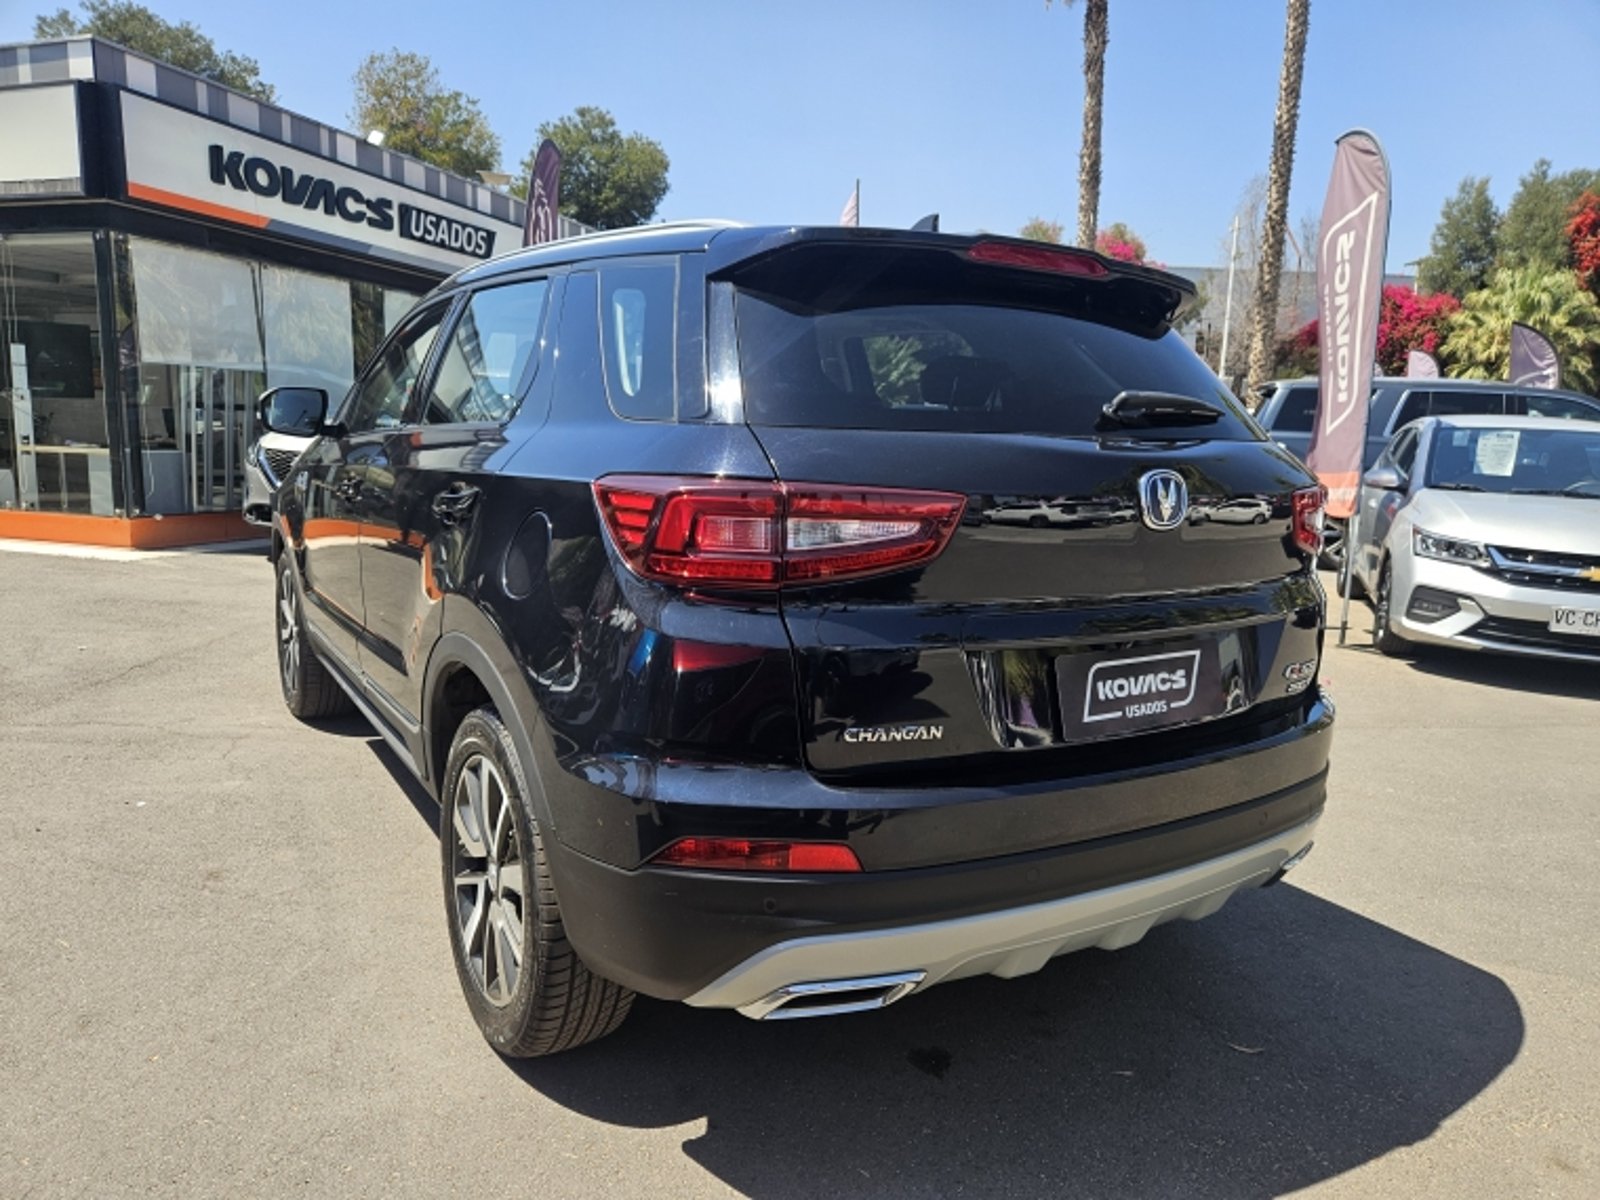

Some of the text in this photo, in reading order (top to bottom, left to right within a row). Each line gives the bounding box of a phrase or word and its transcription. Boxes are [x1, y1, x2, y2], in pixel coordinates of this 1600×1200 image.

[208, 144, 394, 231] KOVACS
[410, 209, 487, 255] USADOS
[1096, 669, 1186, 701] KOVACS
[1125, 700, 1167, 718] USADOS
[843, 725, 944, 742] CHANGAN
